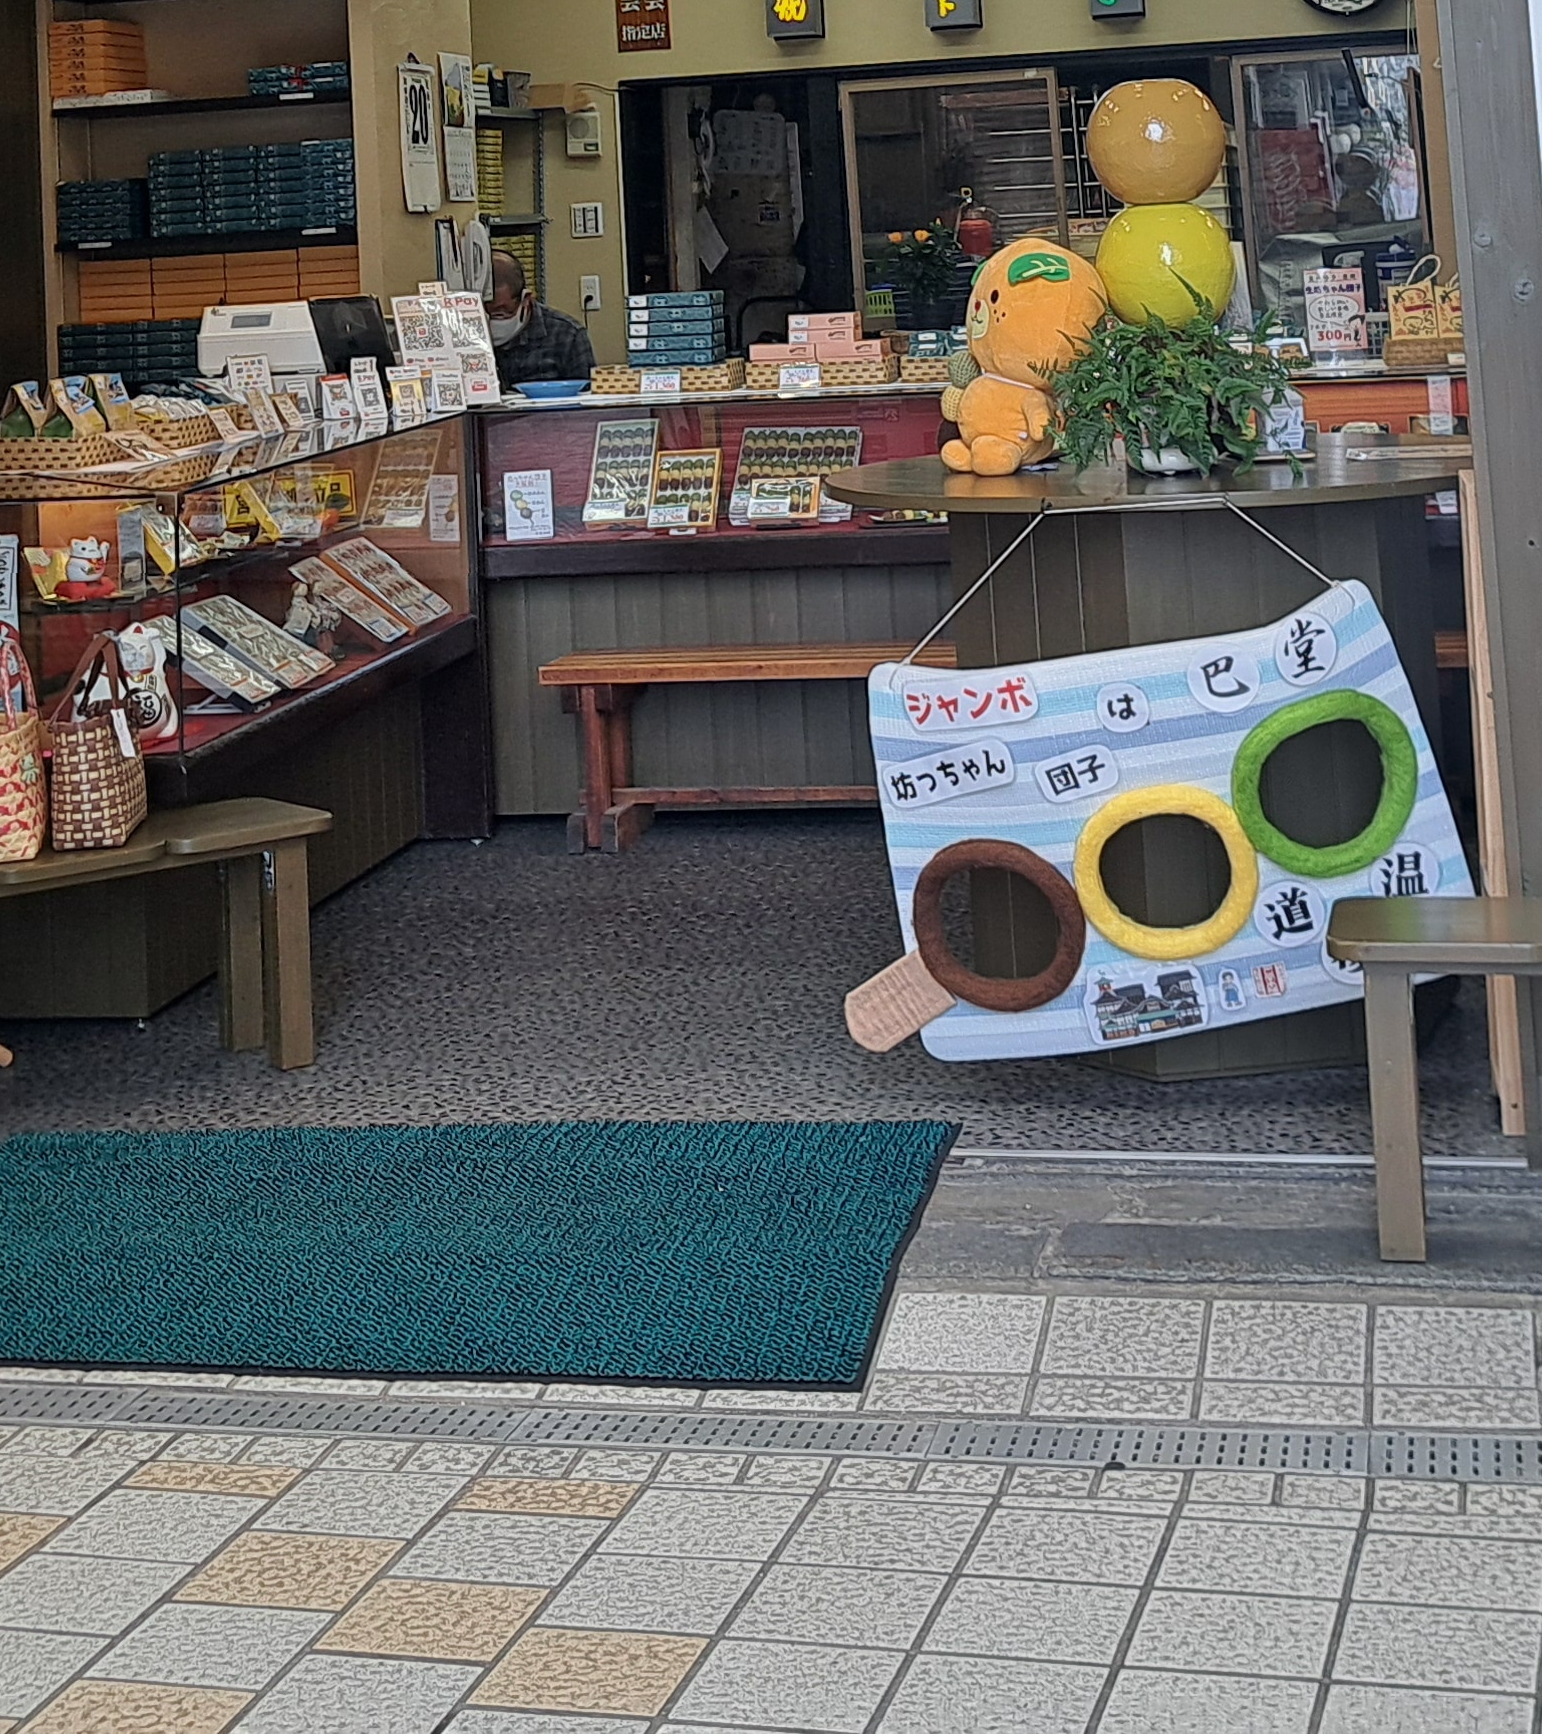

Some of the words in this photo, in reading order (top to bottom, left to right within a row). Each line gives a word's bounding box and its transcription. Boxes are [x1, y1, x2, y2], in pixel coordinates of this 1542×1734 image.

[621, 22, 667, 42] 指定店
[409, 84, 429, 145] 20
[1318, 330, 1351, 341] 300円
[906, 674, 1032, 720] ジャンボ
[1106, 695, 1137, 722] は
[891, 748, 1008, 802] 坊っちゃん
[1044, 755, 1107, 795] 団子
